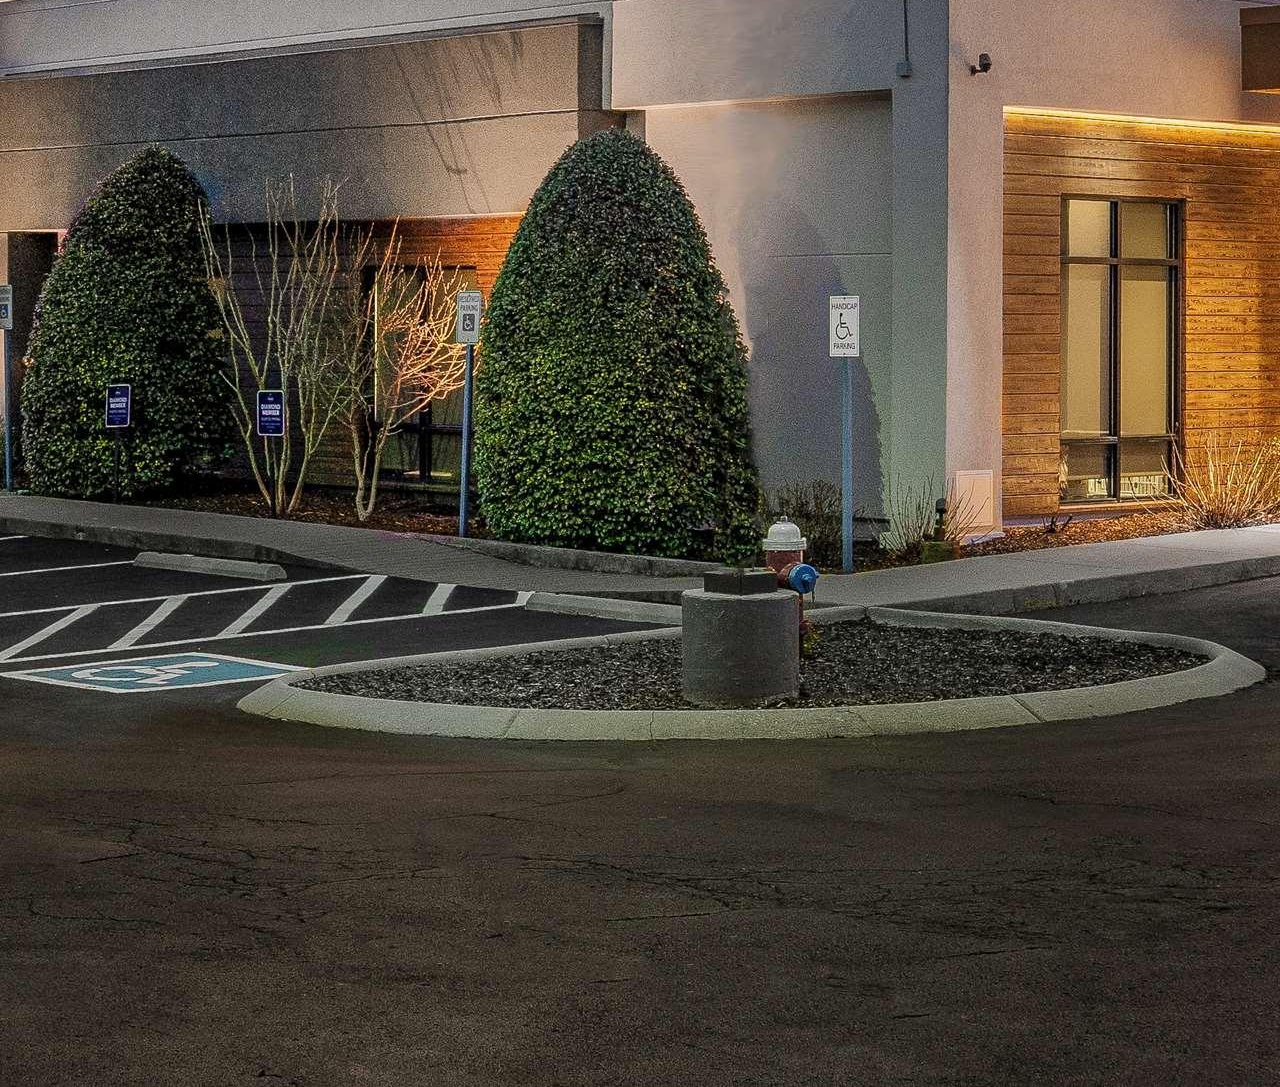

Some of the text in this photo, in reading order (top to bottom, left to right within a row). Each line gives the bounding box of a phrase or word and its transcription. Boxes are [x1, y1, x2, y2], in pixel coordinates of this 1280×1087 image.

[460, 304, 479, 312] PARKING
[832, 302, 858, 311] HANDICAP
[833, 342, 856, 350] PARKING
